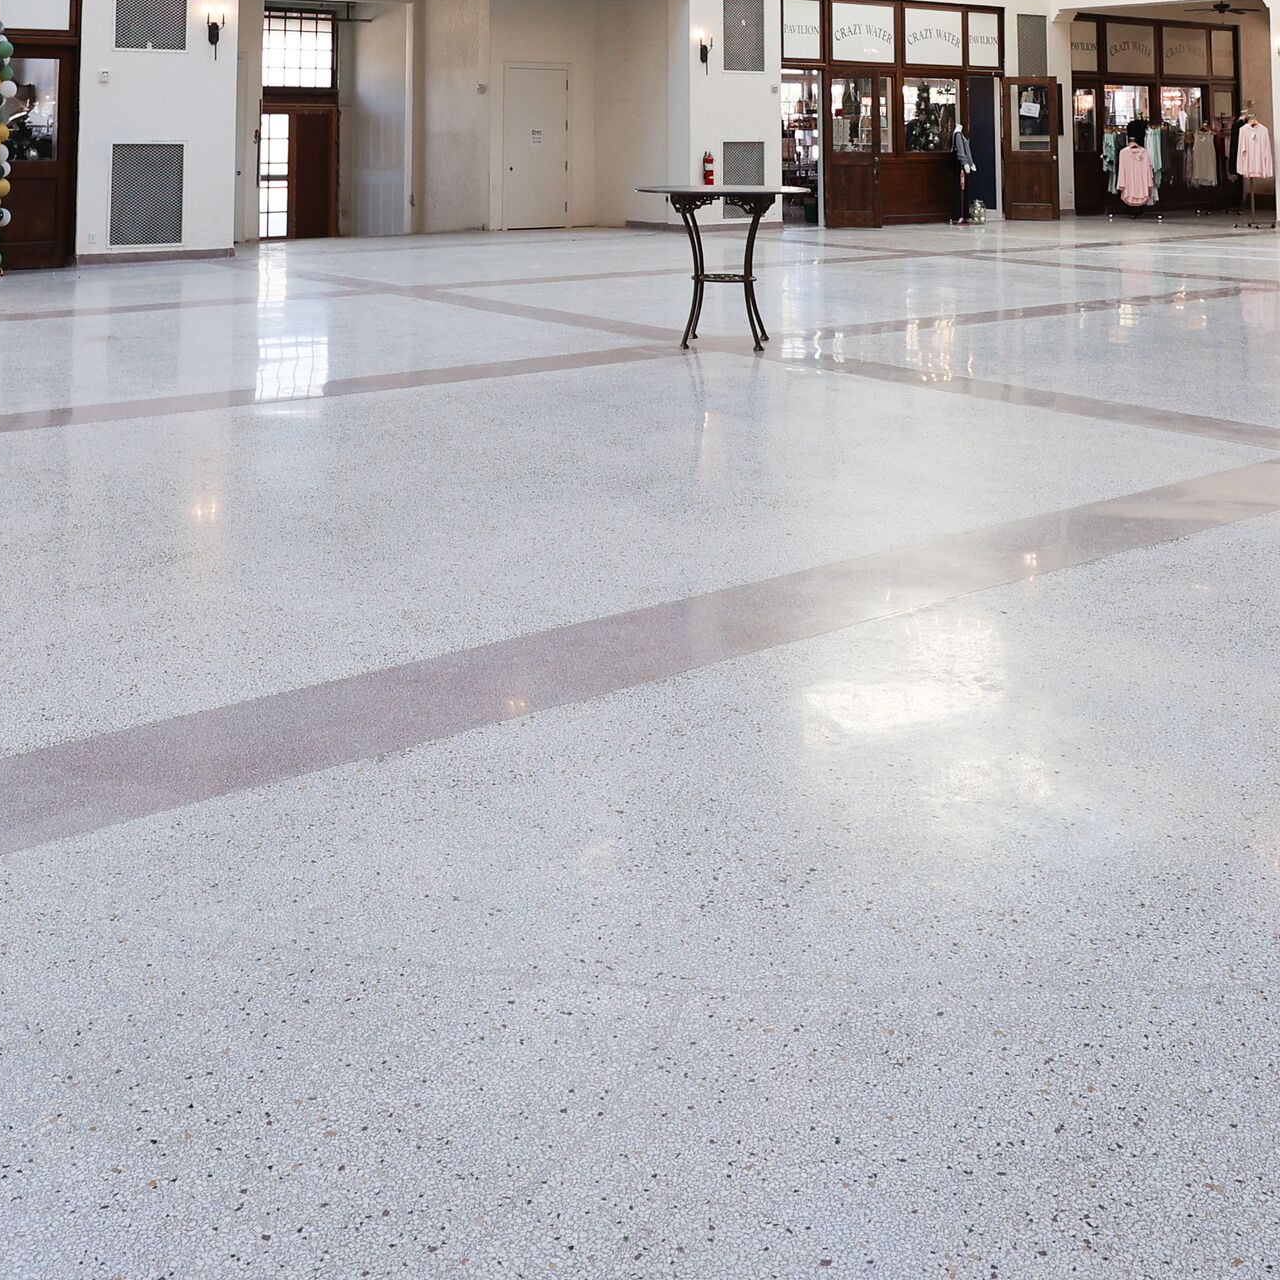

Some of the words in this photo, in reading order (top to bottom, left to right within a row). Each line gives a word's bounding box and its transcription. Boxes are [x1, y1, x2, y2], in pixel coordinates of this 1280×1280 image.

[784, 23, 819, 36] PAVILION
[834, 24, 862, 42] CRAZY
[865, 24, 893, 46] WATER
[907, 28, 933, 46] CRAZY
[935, 29, 961, 49] WATER
[969, 34, 999, 45] PAVILION
[1071, 41, 1098, 52] PAVILION
[1109, 40, 1130, 57] CRAZY
[1131, 41, 1153, 58] WATER
